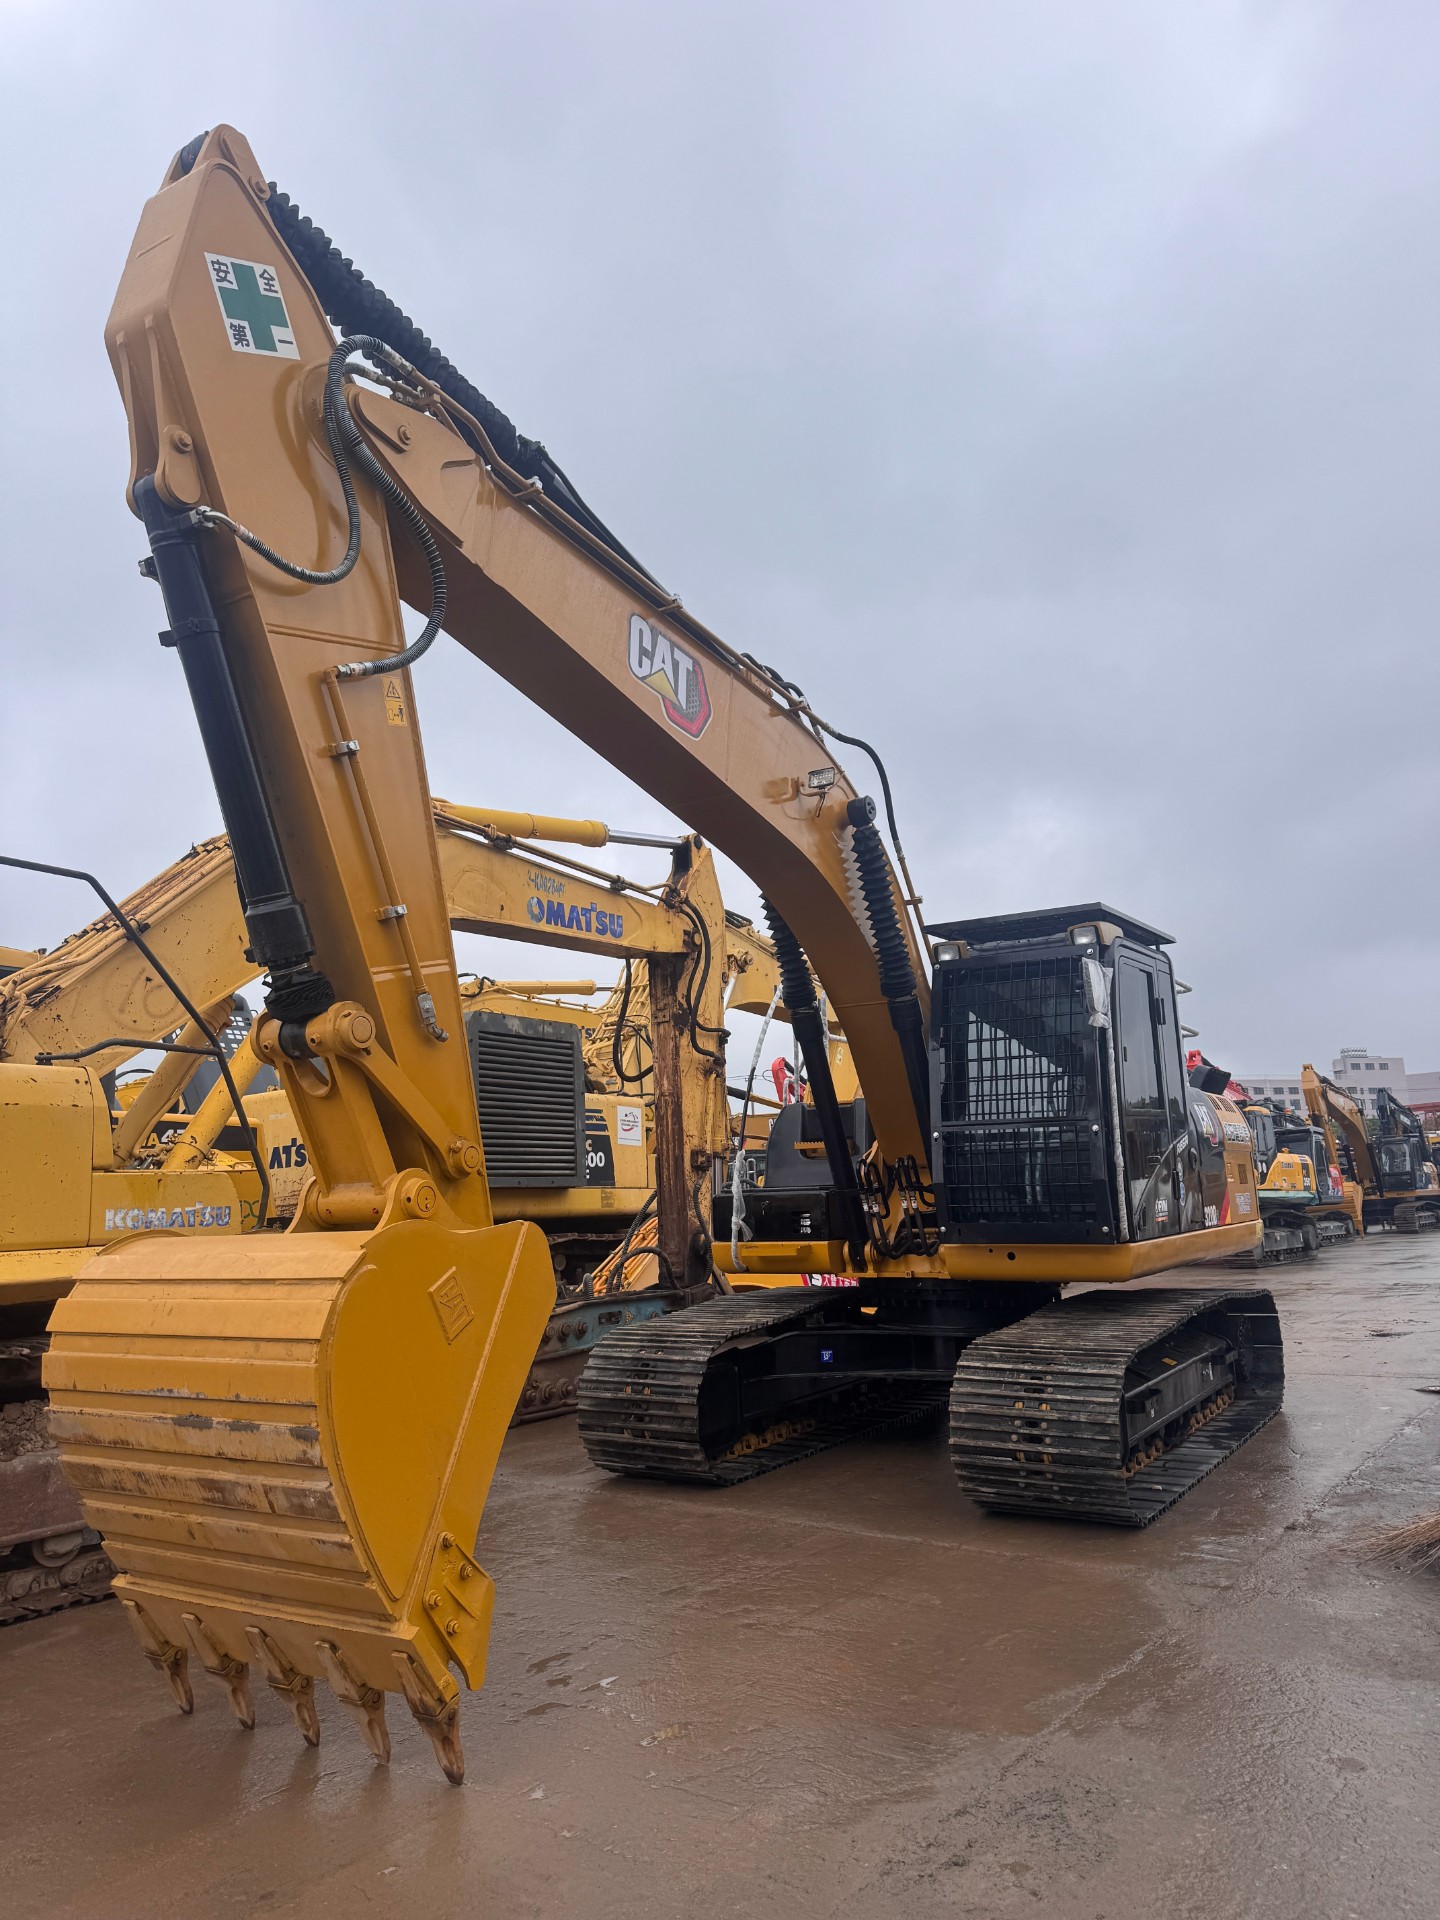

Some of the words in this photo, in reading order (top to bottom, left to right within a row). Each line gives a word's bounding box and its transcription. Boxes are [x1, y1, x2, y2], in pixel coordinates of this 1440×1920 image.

[210, 258, 279, 294] 安全
[229, 321, 294, 348] 第一
[628, 613, 694, 711] CAT
[267, 1137, 308, 1170] ATS
[585, 1151, 605, 1168] 00
[105, 1201, 232, 1232] KOMATSU
